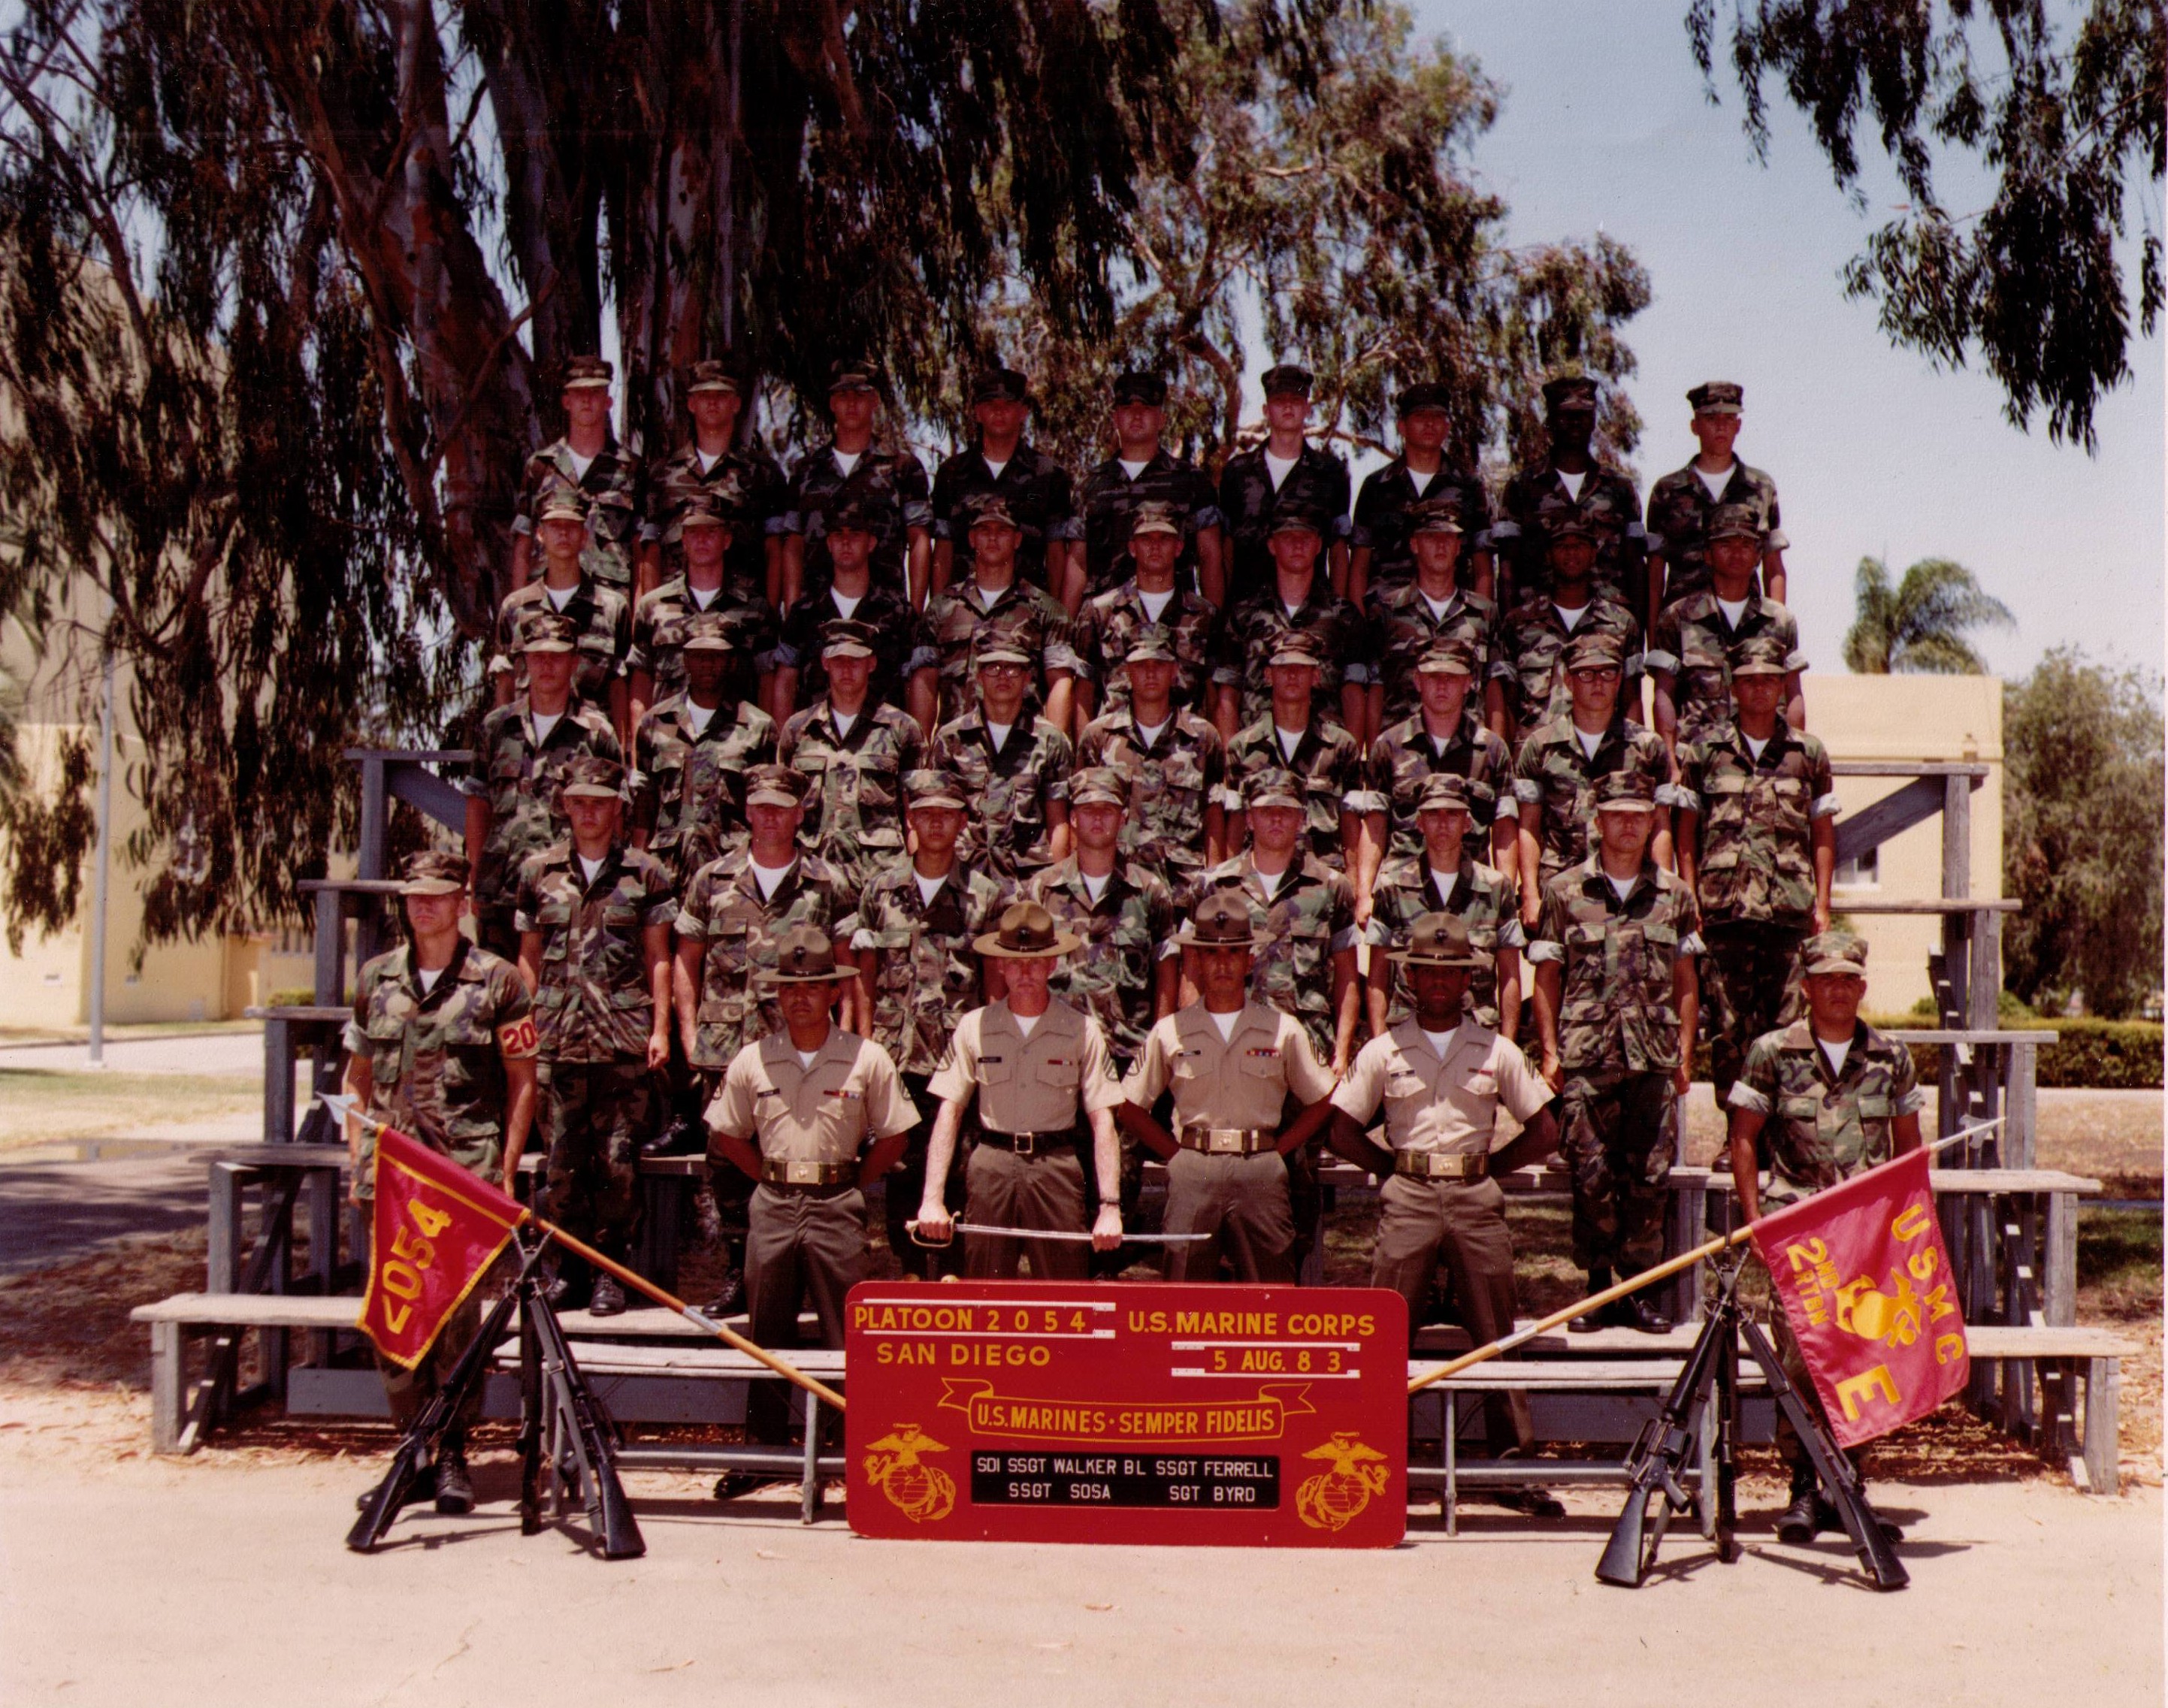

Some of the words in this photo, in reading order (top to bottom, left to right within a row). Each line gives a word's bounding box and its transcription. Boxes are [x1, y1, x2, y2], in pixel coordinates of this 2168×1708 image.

[854, 1307, 972, 1330] PLATOON
[1287, 1314, 1375, 1337] CORPS
[876, 1343, 936, 1365] SAN
[951, 1344, 1051, 1366] DIEGO
[1214, 1350, 1227, 1371] 5
[1241, 1350, 1287, 1371] AUG.
[1834, 1364, 1901, 1423] E
[1119, 1410, 1199, 1434] SEMPER
[1205, 1409, 1274, 1433] FIDELIS
[977, 1457, 1001, 1473] SDI
[1007, 1458, 1047, 1474] SSGT
[1054, 1458, 1117, 1474] WALKER
[1124, 1460, 1147, 1475] BL
[1155, 1460, 1198, 1477] SSGT
[1204, 1461, 1274, 1477] FERRELL
[1008, 1483, 1052, 1498] SSGT
[1070, 1483, 1111, 1499] SOSA
[1169, 1485, 1201, 1501] SGT
[1213, 1486, 1256, 1502] BYRD
